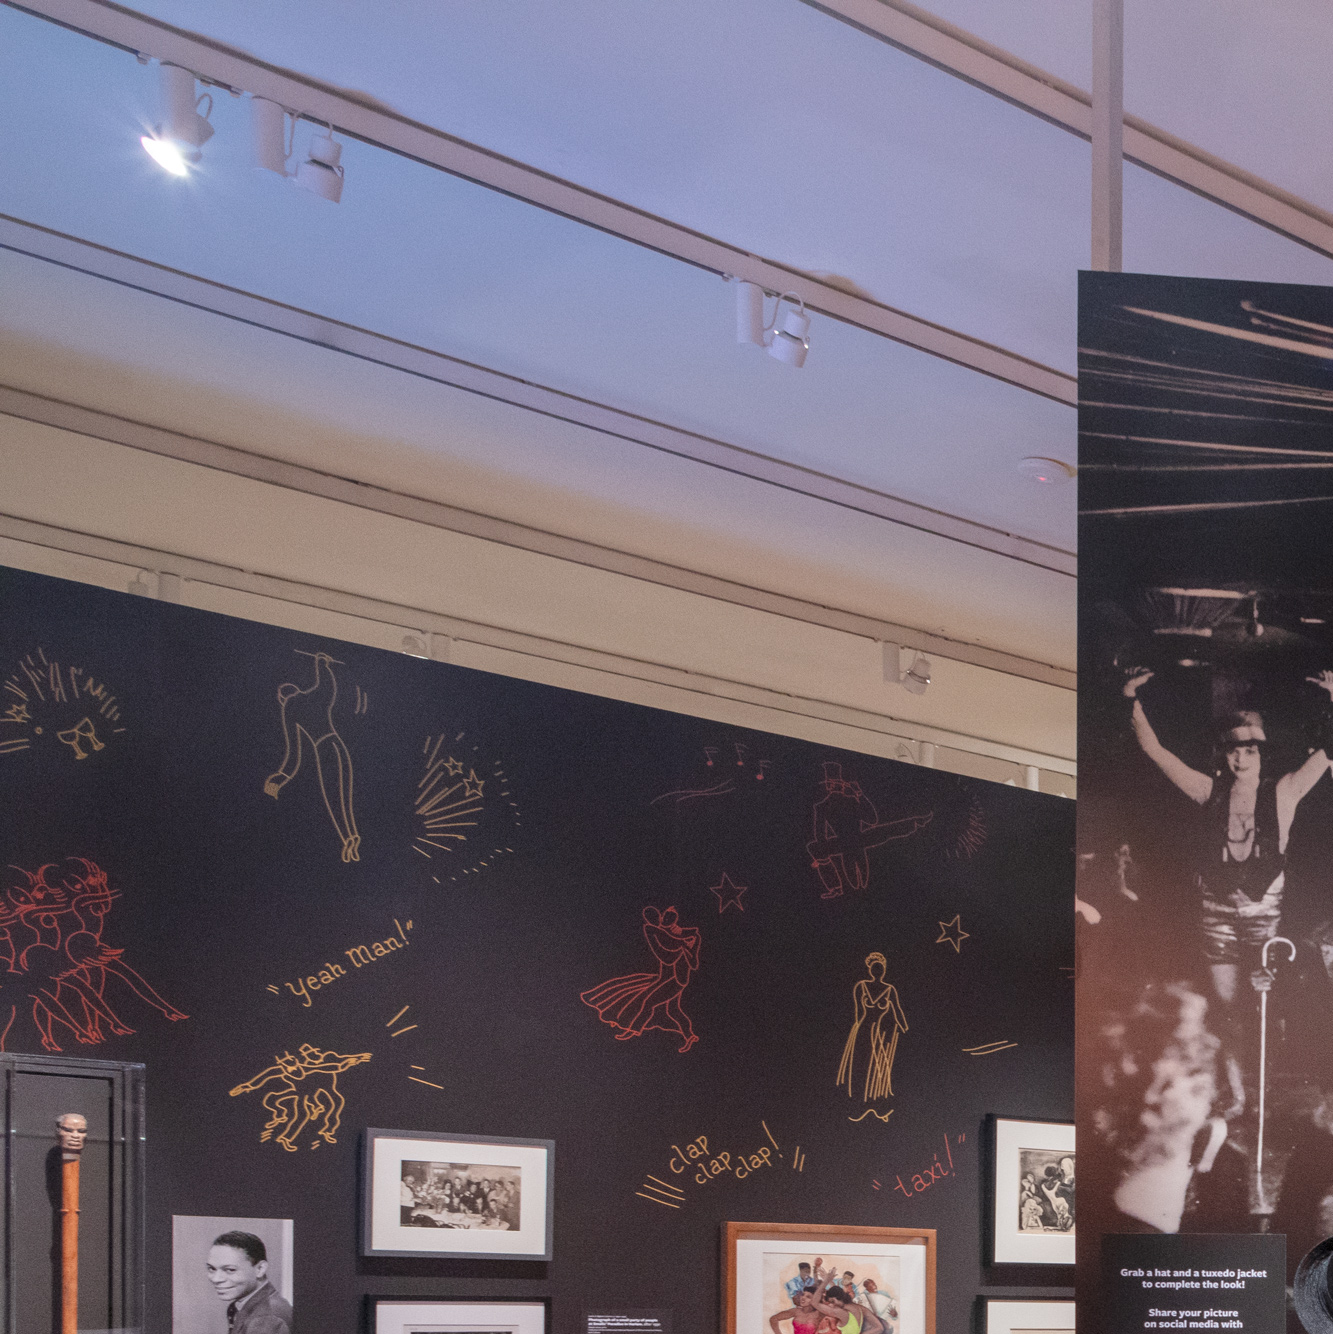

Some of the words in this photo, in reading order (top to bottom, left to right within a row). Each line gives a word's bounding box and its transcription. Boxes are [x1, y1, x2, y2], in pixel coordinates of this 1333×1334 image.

[670, 1136, 710, 1173] clap
[695, 1152, 731, 1184] clap
[736, 1120, 783, 1178] clap!
[1120, 1269, 1144, 1277] Grab
[1155, 1269, 1171, 1277] hat
[1201, 1269, 1235, 1277] tuxedo
[1237, 1269, 1267, 1279] jacket
[1155, 1280, 1200, 1290] complete
[1202, 1280, 1218, 1289] the
[1221, 1280, 1245, 1289] look!
[1149, 1308, 1177, 1317] Share
[1179, 1310, 1201, 1319] your
[1204, 1309, 1238, 1319] picture
[1159, 1320, 1187, 1328] social
[1189, 1320, 1219, 1328] media
[1221, 1320, 1243, 1328] with
